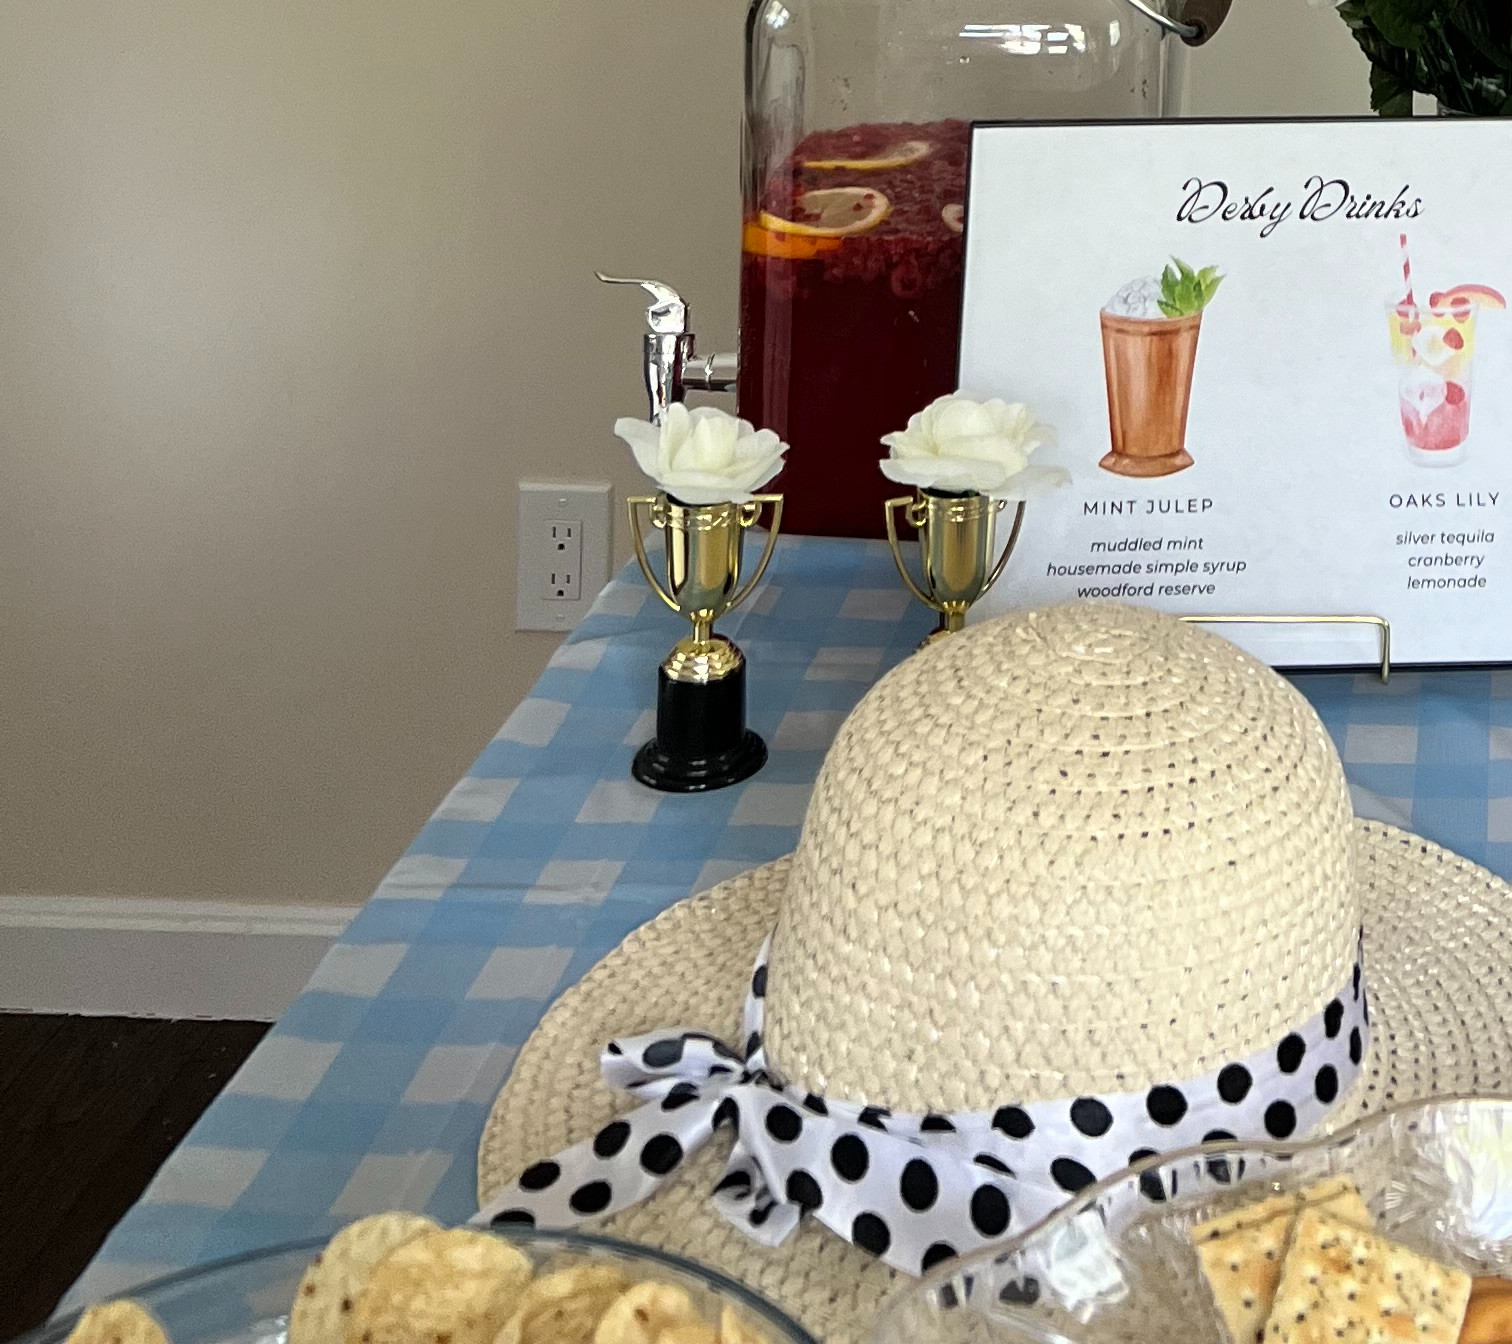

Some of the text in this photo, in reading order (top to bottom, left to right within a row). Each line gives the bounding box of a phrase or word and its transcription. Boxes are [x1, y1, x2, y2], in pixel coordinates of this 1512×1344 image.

[1176, 175, 1424, 238] Derby Drinks
[1083, 498, 1213, 516] MINT JULEP
[1389, 491, 1499, 508] OAKS LILY
[1090, 536, 1203, 553] muddled mint
[1395, 529, 1495, 546] silver tequila
[1047, 559, 1247, 576] housemade simple syrup
[1408, 552, 1485, 569] cranberry
[1078, 582, 1216, 598] woodford reserve
[1407, 574, 1487, 589] lemonade
